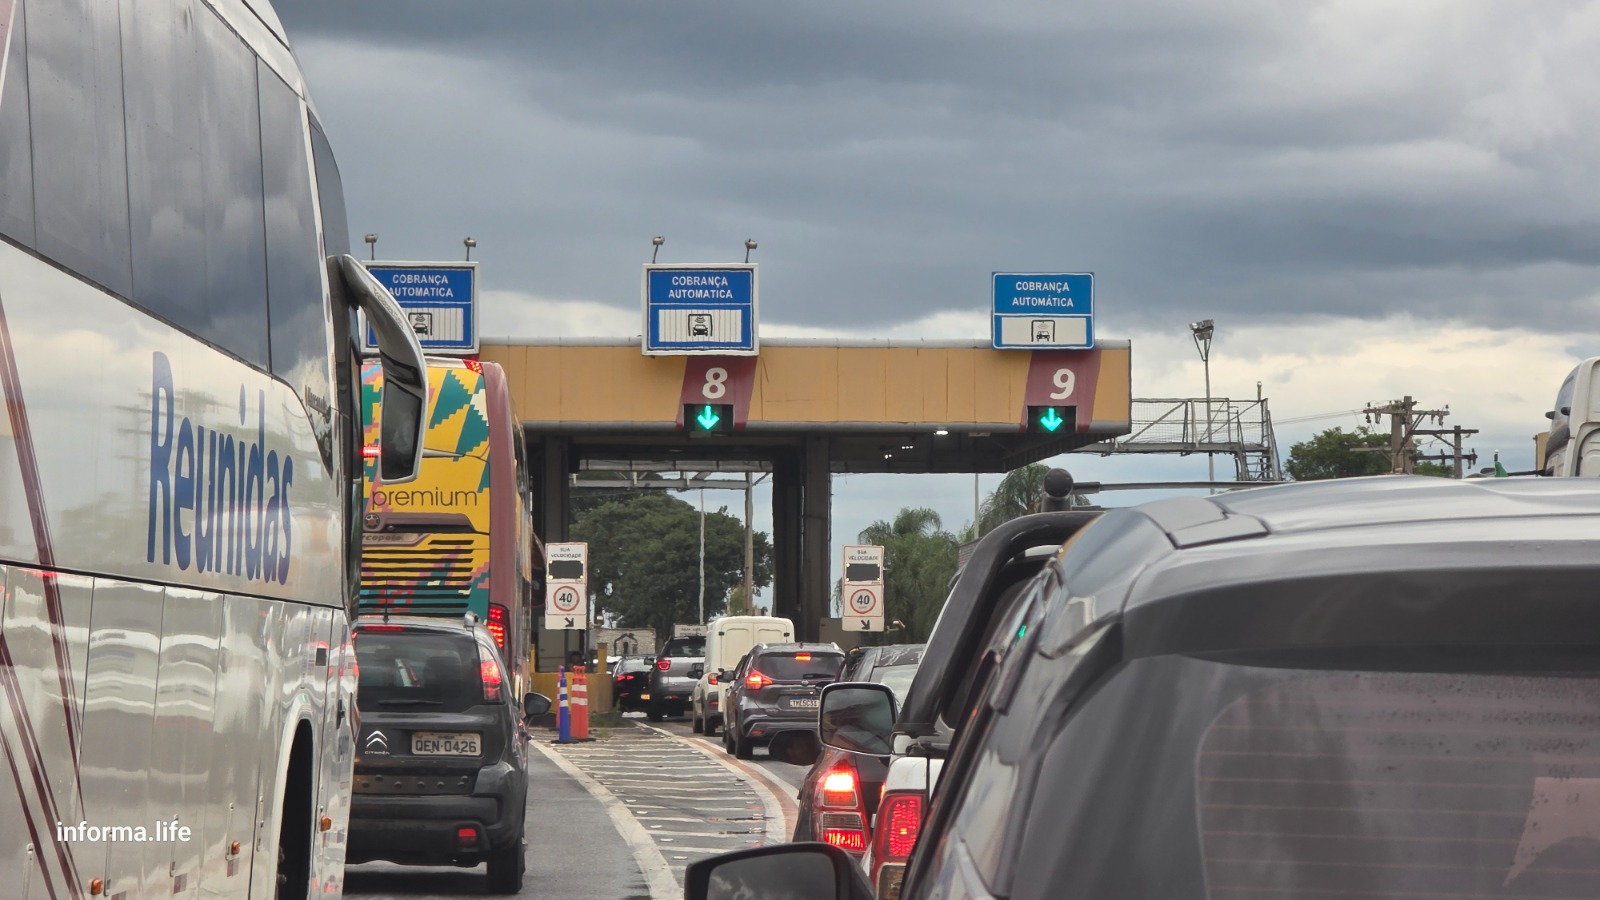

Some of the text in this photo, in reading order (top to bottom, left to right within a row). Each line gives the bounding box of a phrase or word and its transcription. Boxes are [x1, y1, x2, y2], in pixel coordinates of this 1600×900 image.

[392, 274, 448, 285] COBRANÇA
[671, 276, 728, 288] COBRANÇA
[1015, 281, 1070, 293] COBRANÇA
[1012, 294, 1074, 307] AUTOMÁTICA
[702, 367, 728, 399] 8
[1049, 368, 1075, 400] 9
[147, 351, 293, 586] Reunidas
[372, 486, 478, 511] premium
[559, 592, 573, 603] 40
[857, 594, 870, 605] 40
